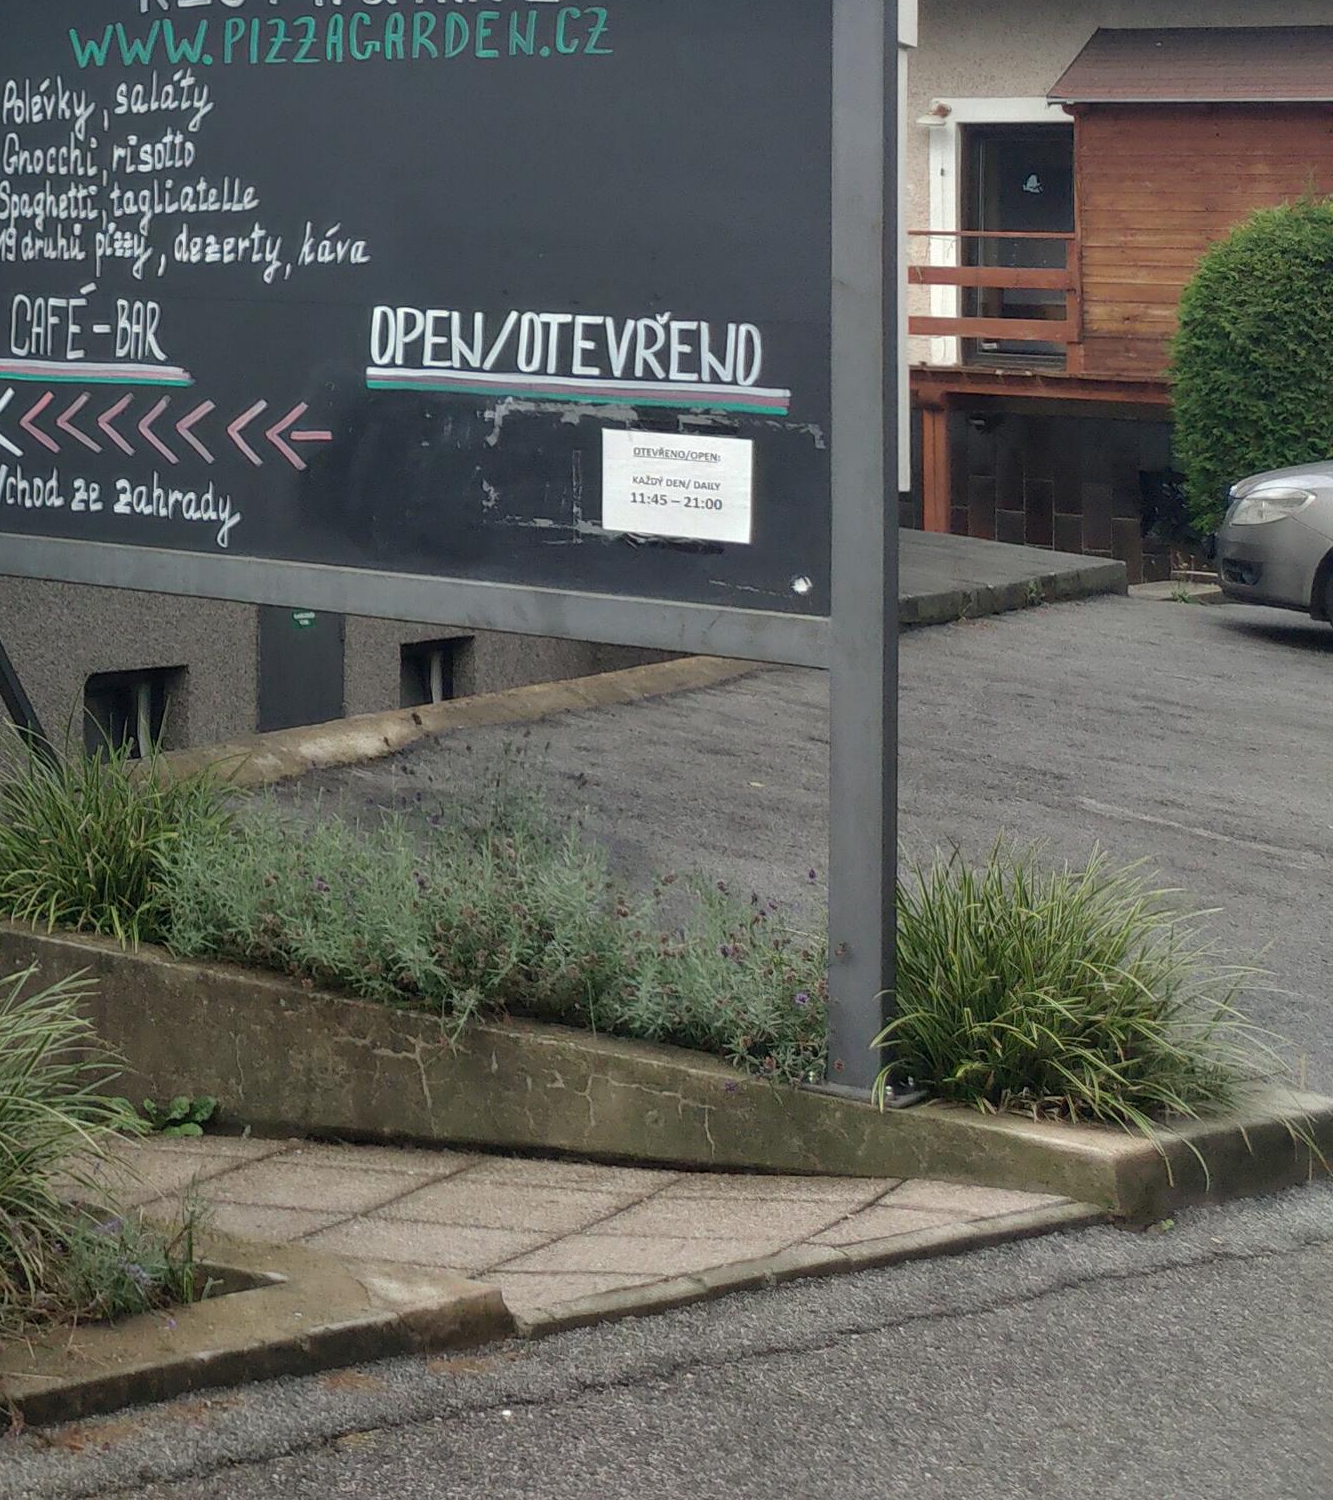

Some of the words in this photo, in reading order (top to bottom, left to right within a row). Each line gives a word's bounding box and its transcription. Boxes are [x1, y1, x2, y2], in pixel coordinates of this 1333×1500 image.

[69, 6, 614, 69] WWW.PIZZAGARDEN.CZ
[114, 67, 214, 132] saláty
[112, 126, 195, 173] risotto
[110, 175, 260, 236] tagliatelle
[298, 221, 372, 266] káva
[370, 306, 763, 386] OPEN/OTEVŘENO
[633, 447, 721, 462] OTEVŘENO/OPEN:
[71, 478, 103, 512] ze
[114, 471, 241, 548] zahrady
[630, 492, 668, 506] 11:45
[684, 497, 723, 511] 21:00
[632, 475, 663, 487] KAŽDÝ
[694, 481, 721, 491] DAILY
